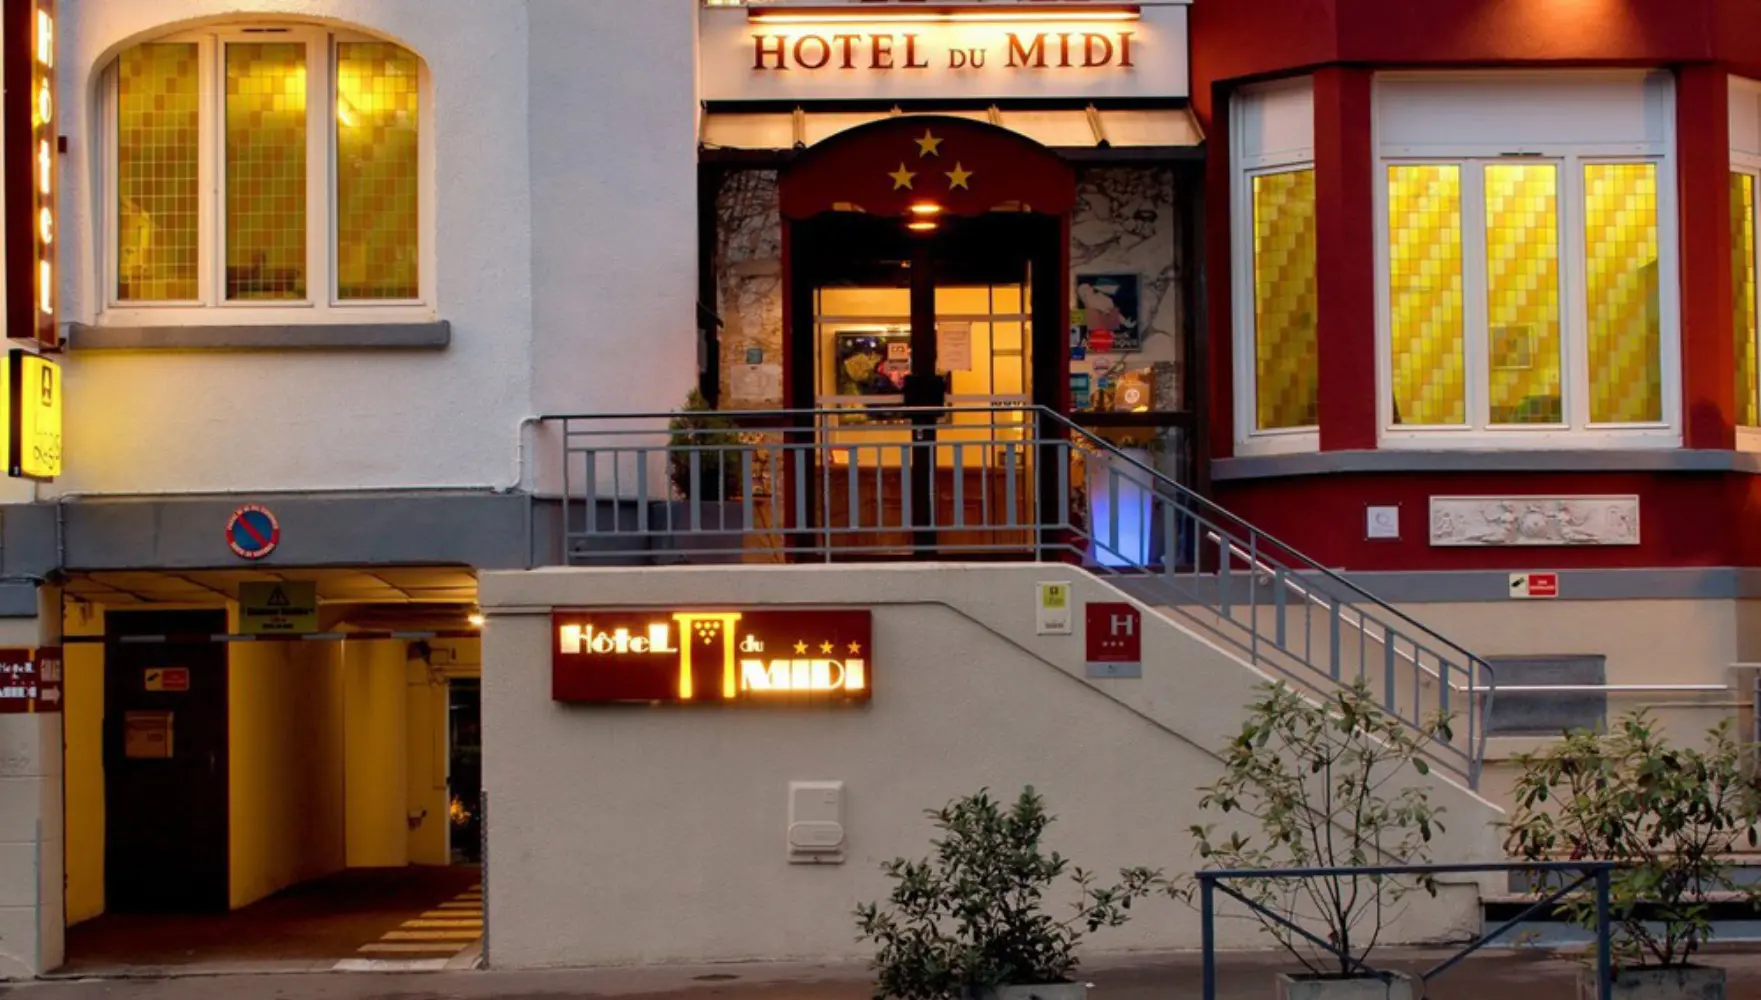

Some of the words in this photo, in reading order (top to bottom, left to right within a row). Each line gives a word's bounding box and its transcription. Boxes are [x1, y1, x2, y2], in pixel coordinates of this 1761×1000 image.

[751, 33, 929, 70] HOTEL
[948, 48, 987, 70] DU
[1004, 31, 1135, 69] MIDI
[1110, 614, 1134, 636] H
[740, 634, 764, 652] du
[740, 658, 865, 690] MIDI
